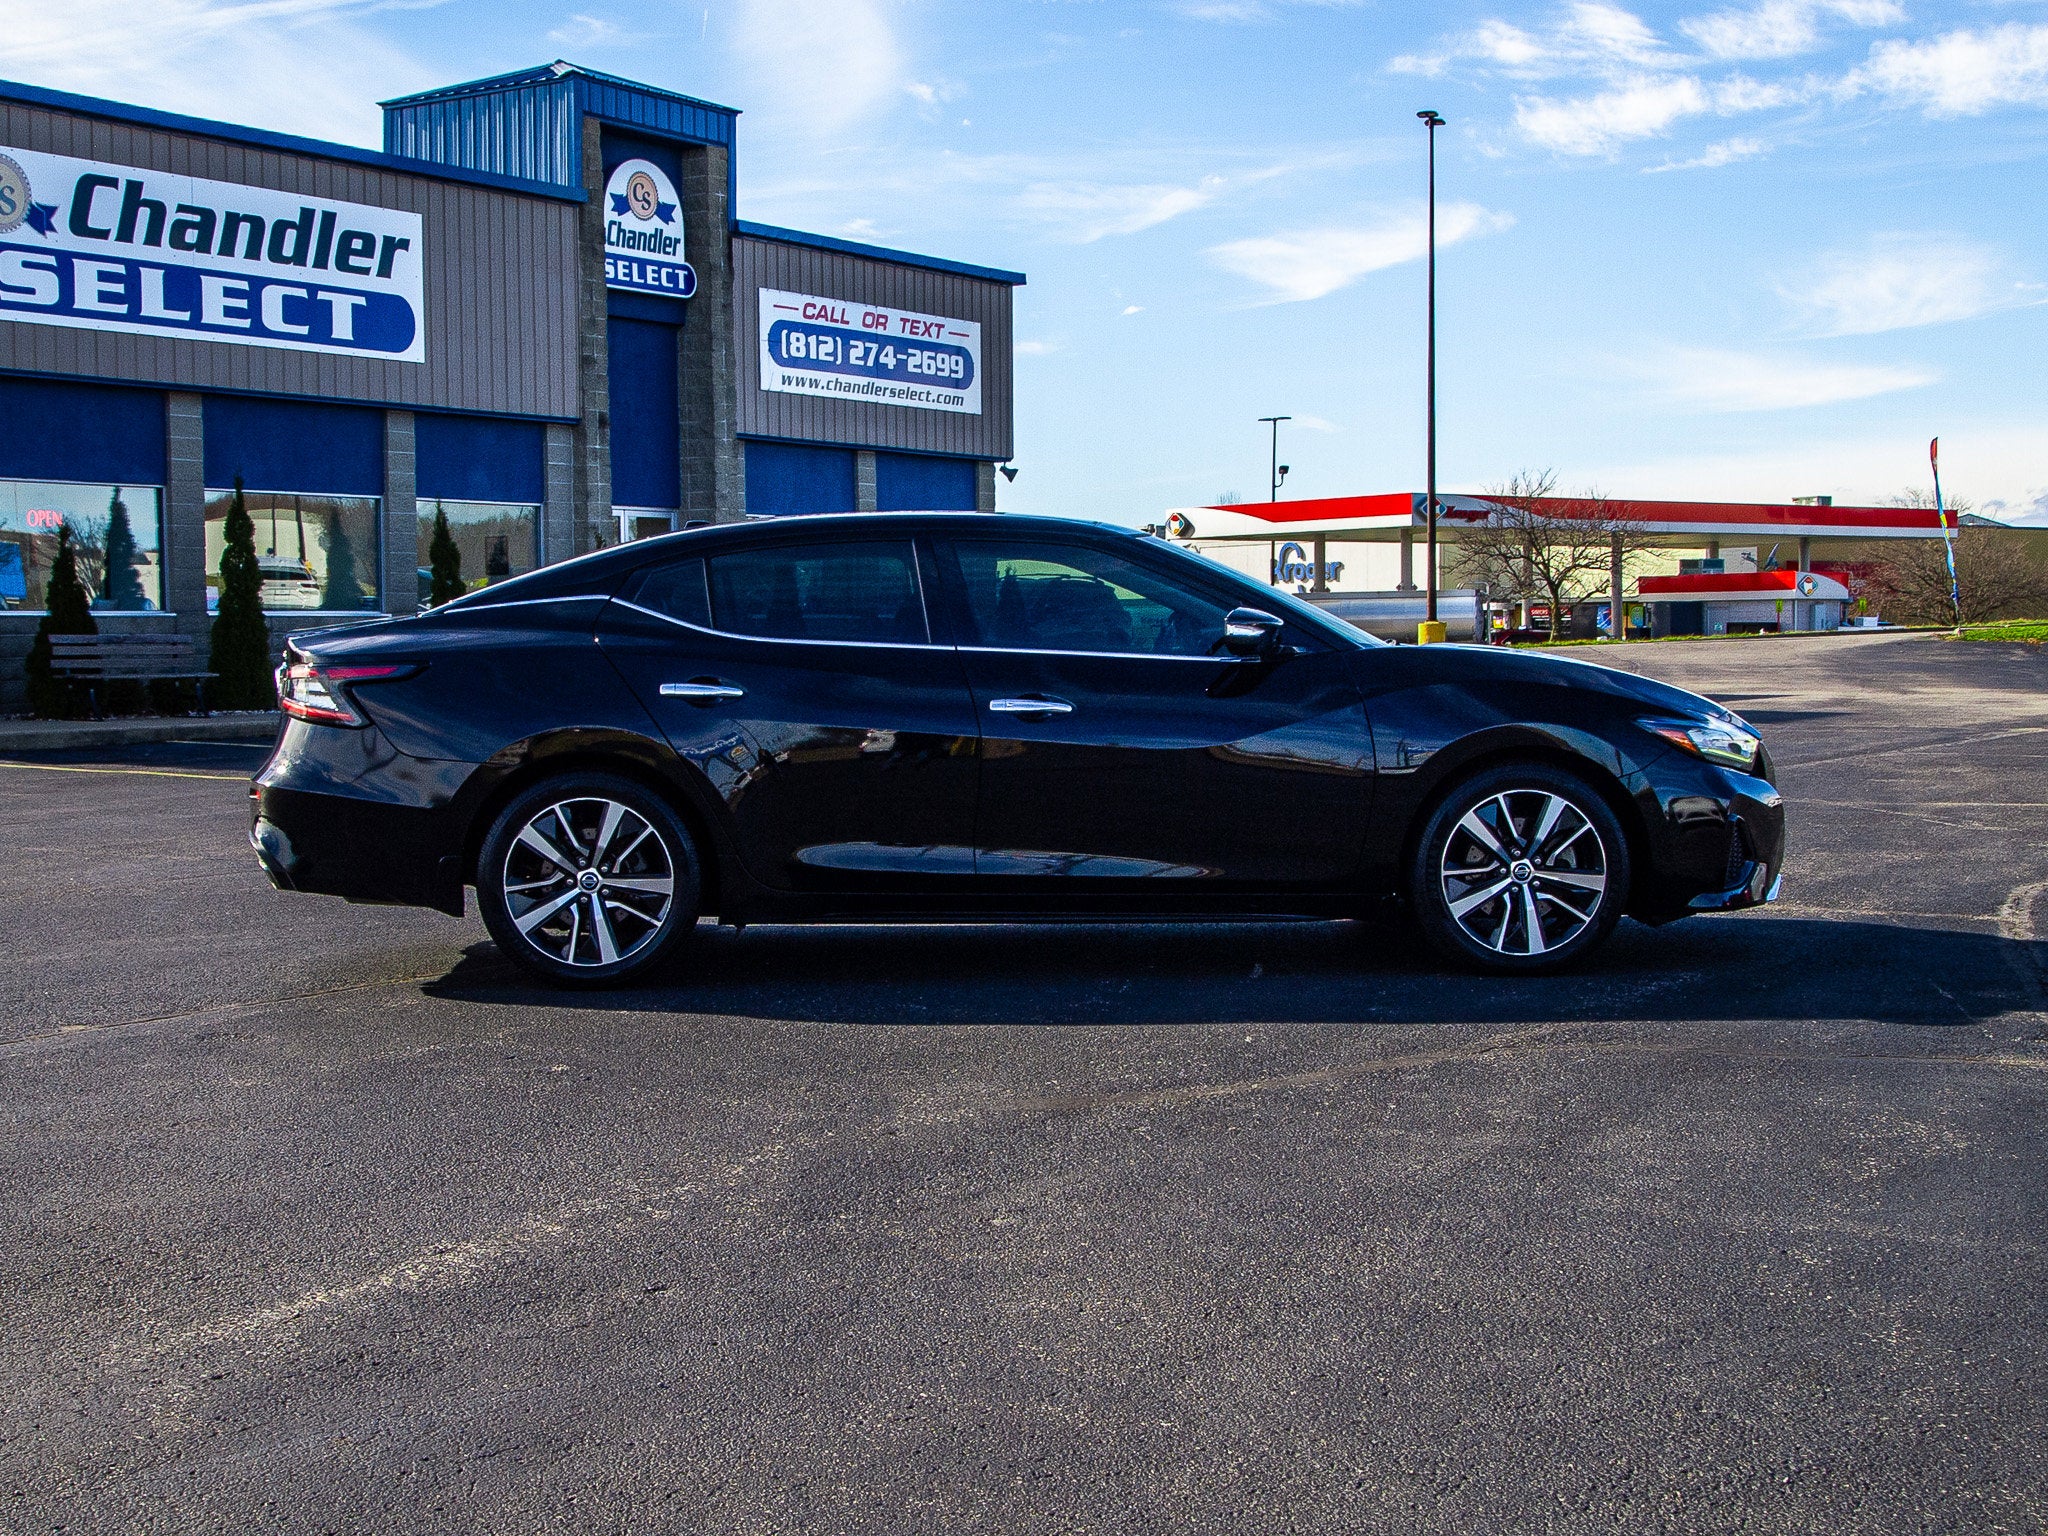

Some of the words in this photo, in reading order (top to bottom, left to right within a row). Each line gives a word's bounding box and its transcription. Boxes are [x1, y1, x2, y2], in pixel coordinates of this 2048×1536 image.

[68, 172, 411, 279] Chandler
[606, 219, 681, 257] Chandler
[604, 258, 688, 290] SELECT
[0, 249, 367, 341] SELECT
[802, 302, 850, 326] CALL
[861, 311, 889, 331] OR
[899, 317, 946, 340] TEXT
[780, 328, 843, 366] (812)
[849, 339, 965, 379] 274-2699
[780, 372, 965, 407] www.chandlerselect.com
[26, 509, 63, 528] OPEN
